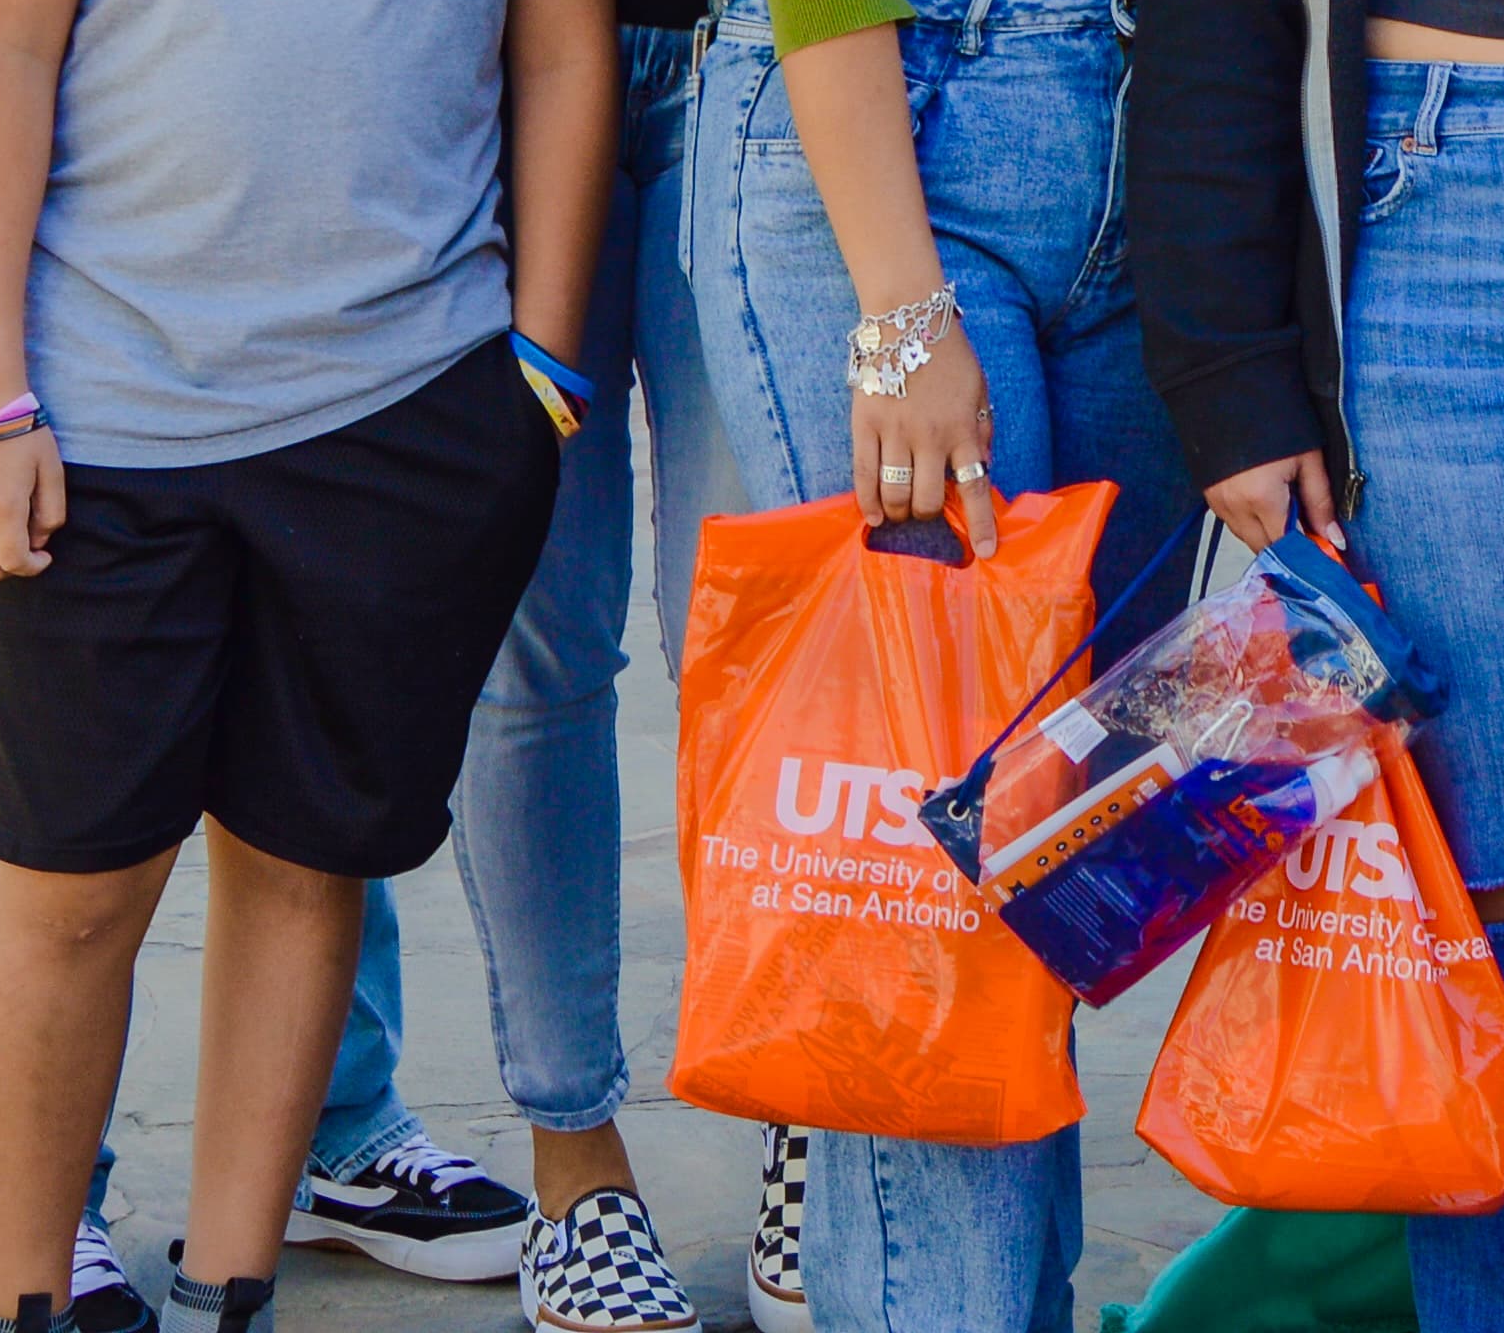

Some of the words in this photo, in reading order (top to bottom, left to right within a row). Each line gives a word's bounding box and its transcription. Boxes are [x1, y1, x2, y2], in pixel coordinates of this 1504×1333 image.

[701, 834, 760, 870] The
[770, 843, 923, 895] University
[751, 882, 783, 911] at
[790, 883, 853, 920] San
[1277, 898, 1404, 950] University
[1254, 936, 1286, 963] at
[1290, 935, 1334, 970] San
